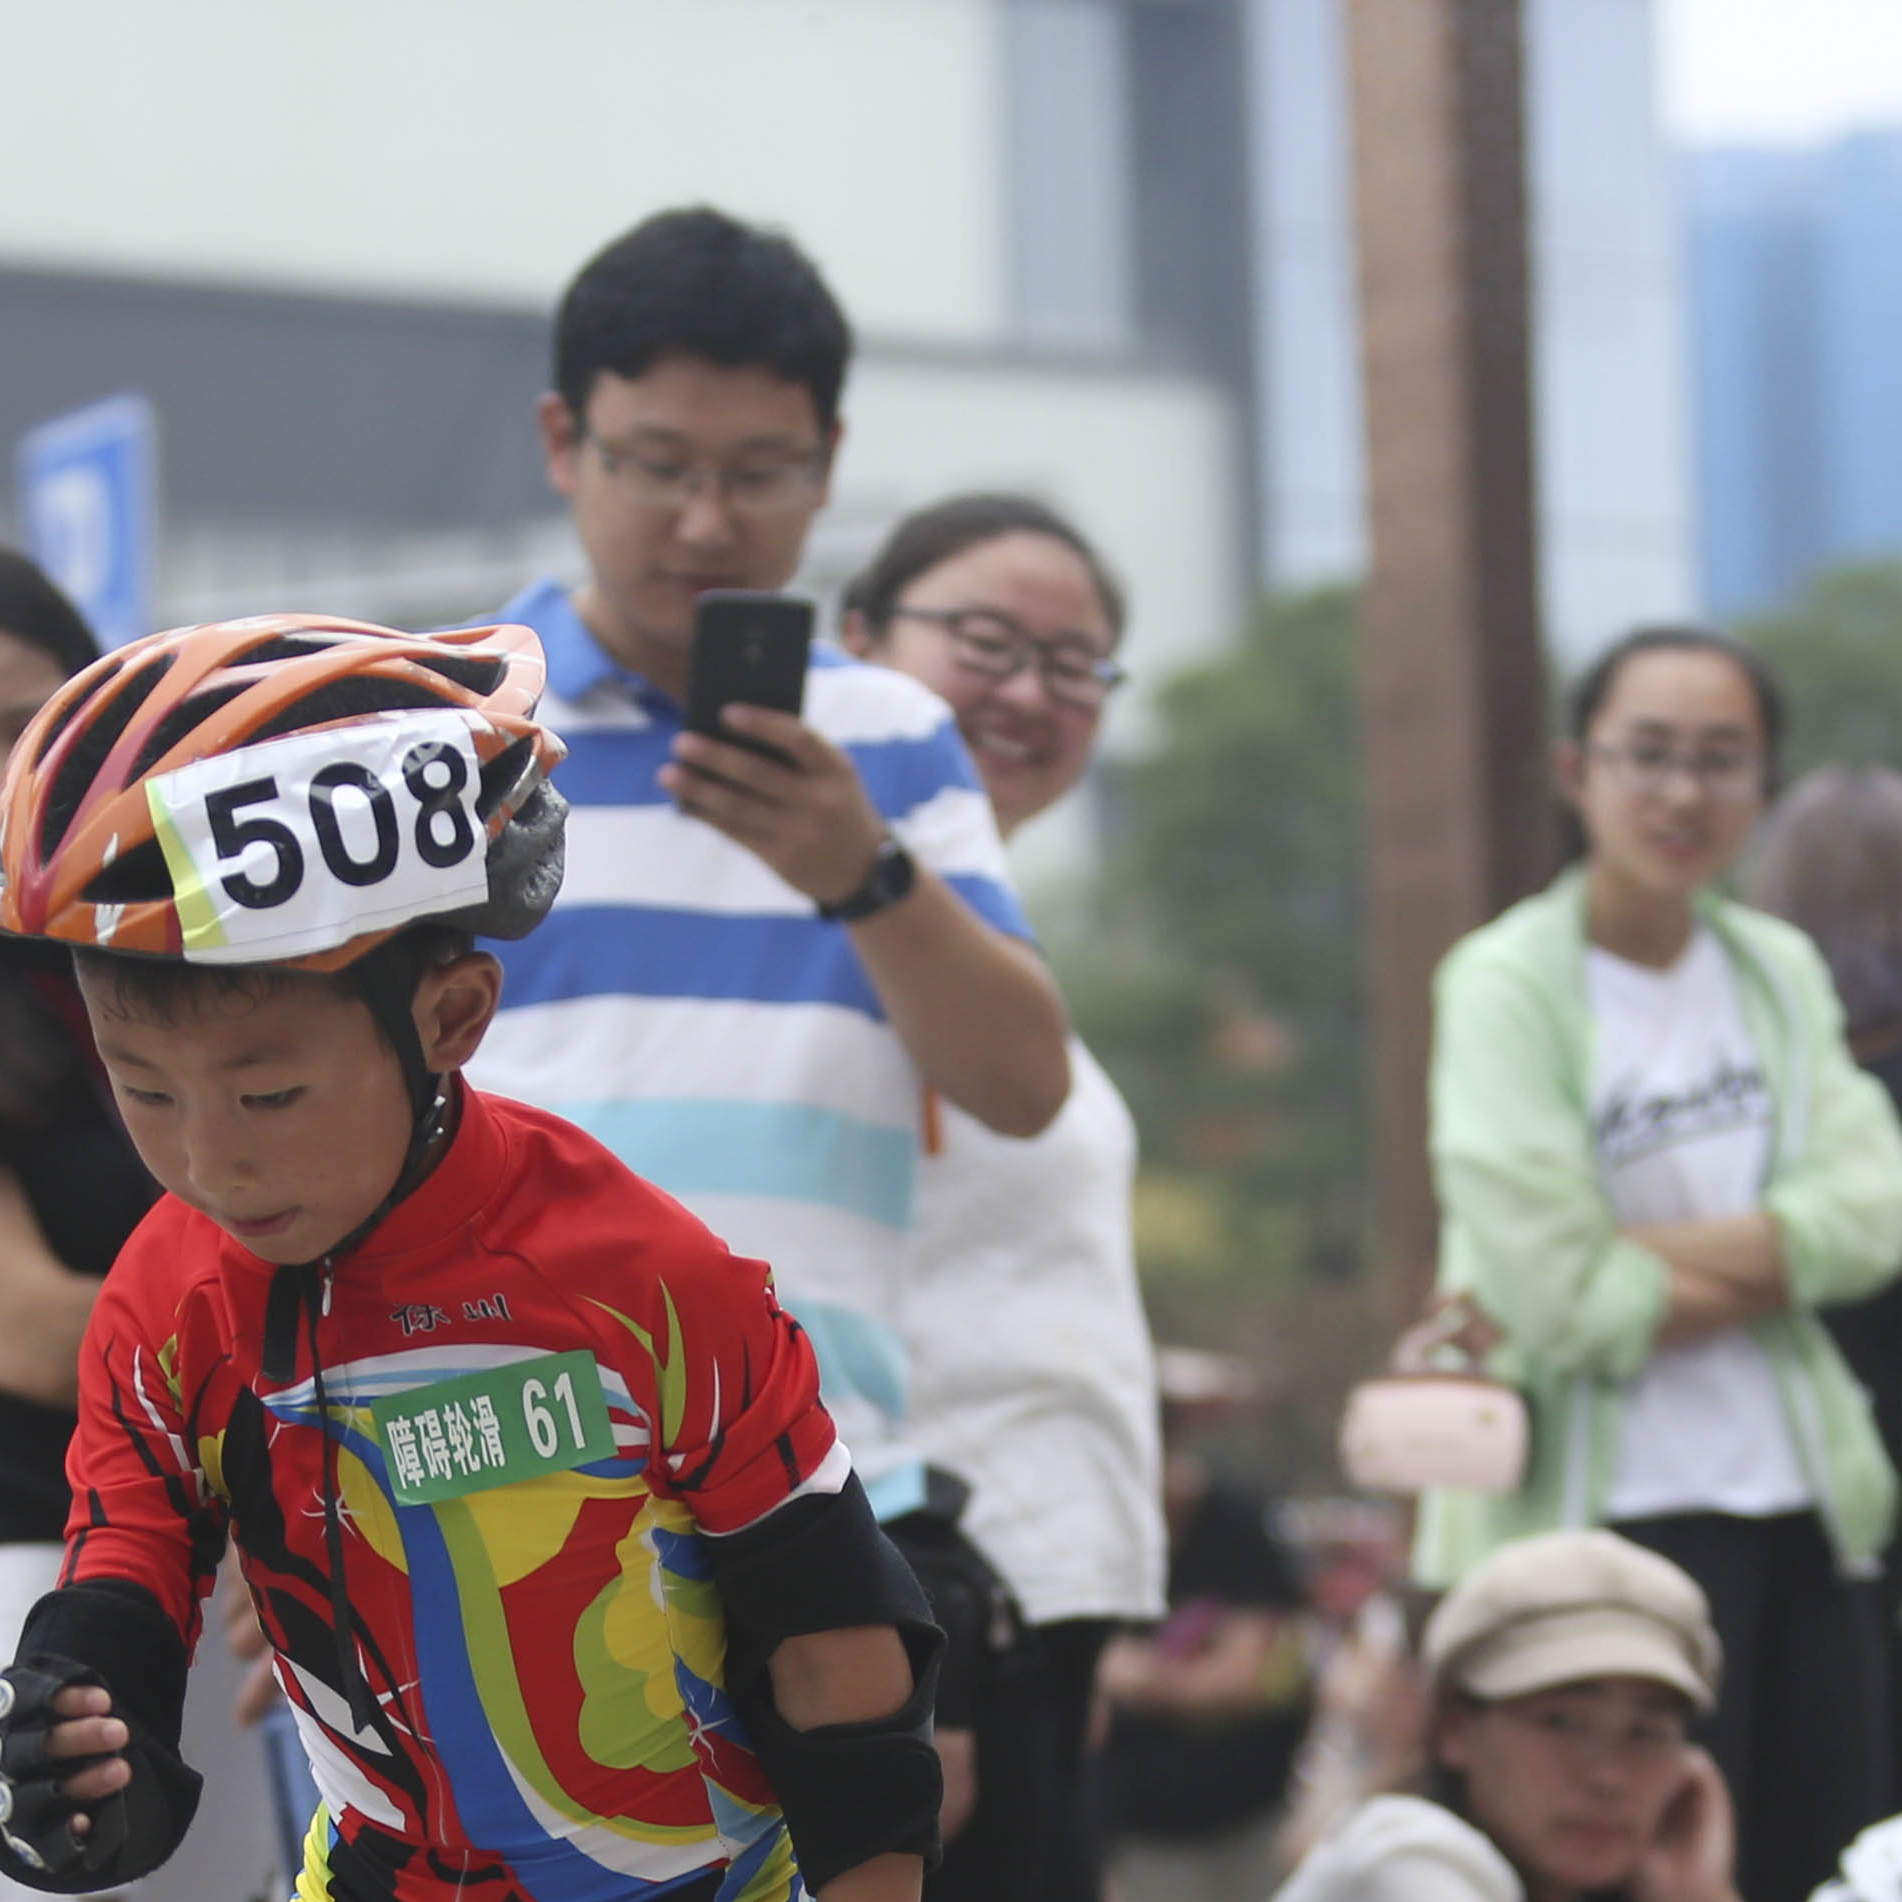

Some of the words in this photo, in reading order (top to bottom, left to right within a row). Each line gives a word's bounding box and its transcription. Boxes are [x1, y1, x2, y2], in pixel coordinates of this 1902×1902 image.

[203, 740, 476, 910] 508
[385, 1394, 506, 1490] 障碍轮滑
[522, 1372, 586, 1459] 61
